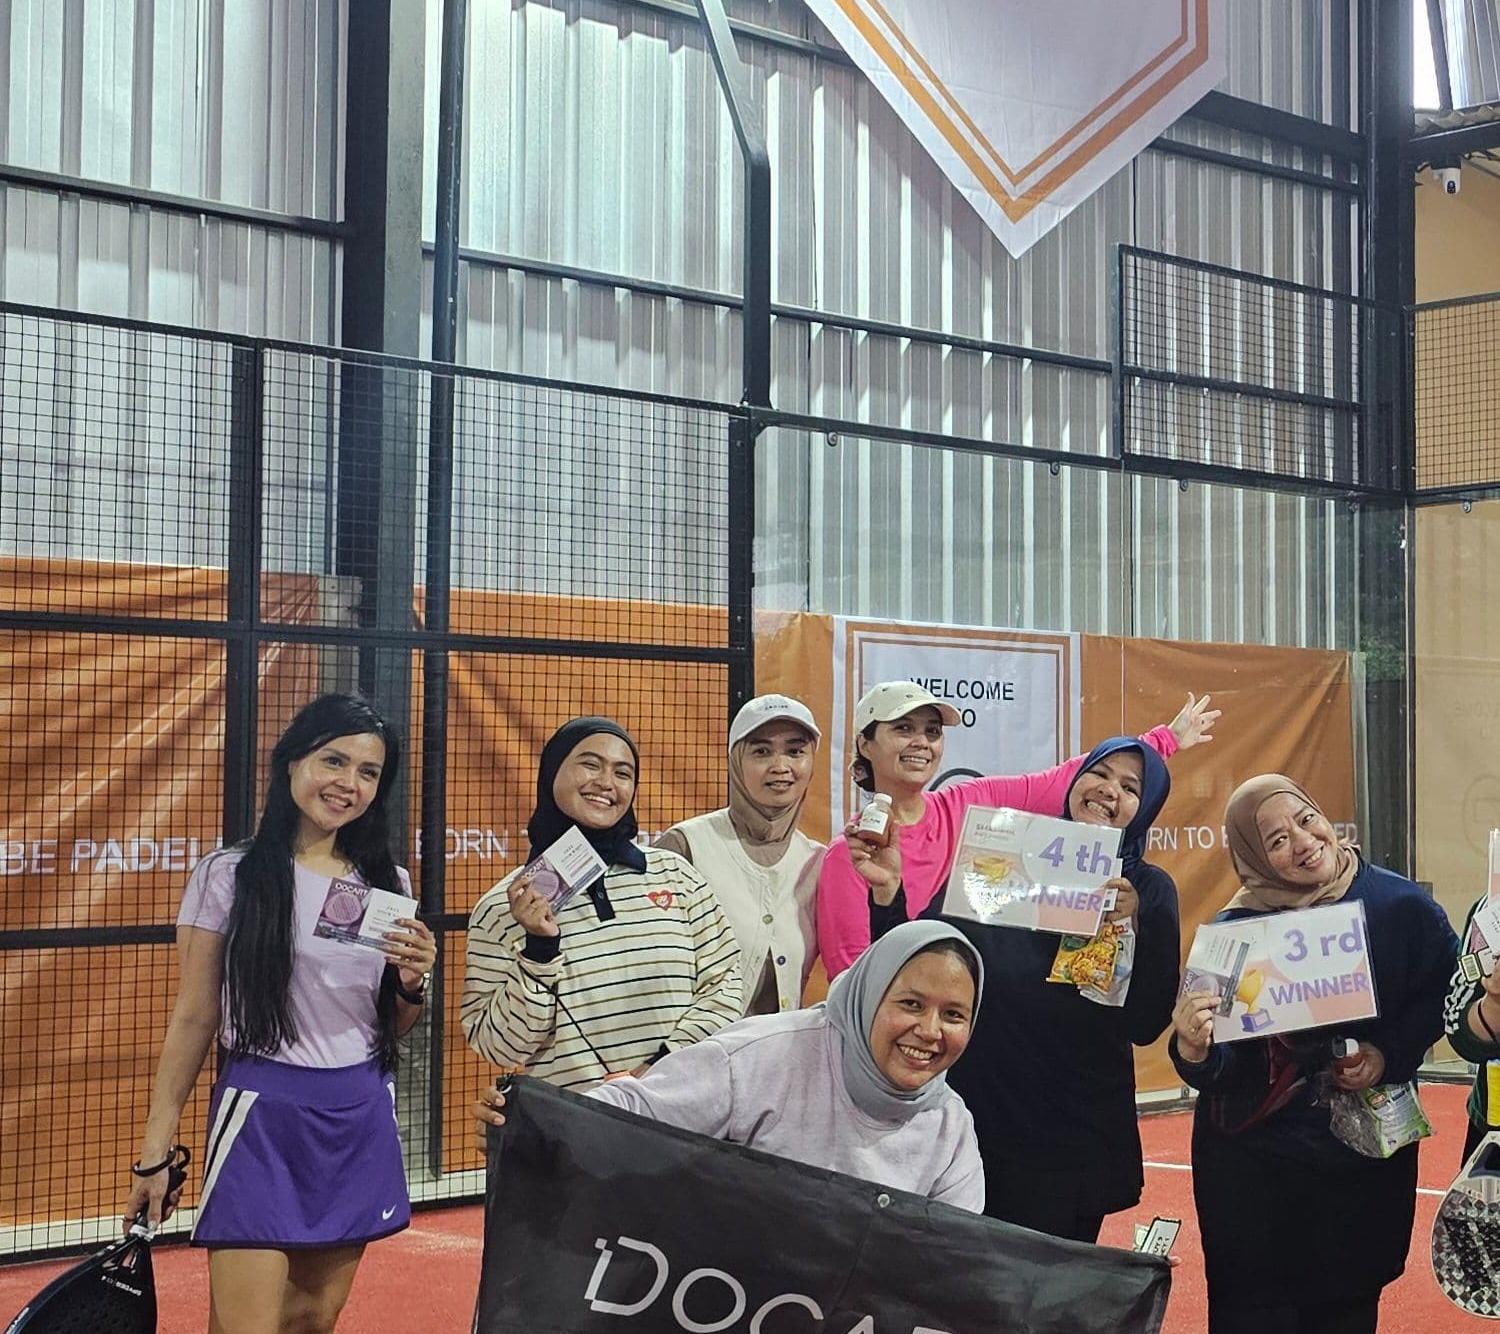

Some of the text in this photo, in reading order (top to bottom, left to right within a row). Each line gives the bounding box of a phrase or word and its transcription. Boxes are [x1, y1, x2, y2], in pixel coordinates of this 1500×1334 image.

[911, 678, 1014, 701] WELCOME
[957, 708, 976, 727] O
[415, 827, 508, 860] ORN
[1147, 826, 1177, 851] RN
[1184, 825, 1215, 850] TO
[0, 836, 223, 876] BE PADEL
[1038, 835, 1112, 876] 4 th
[1020, 885, 1101, 913] NNER
[1284, 919, 1364, 962] 3 rd
[1269, 971, 1370, 1006] WINNER
